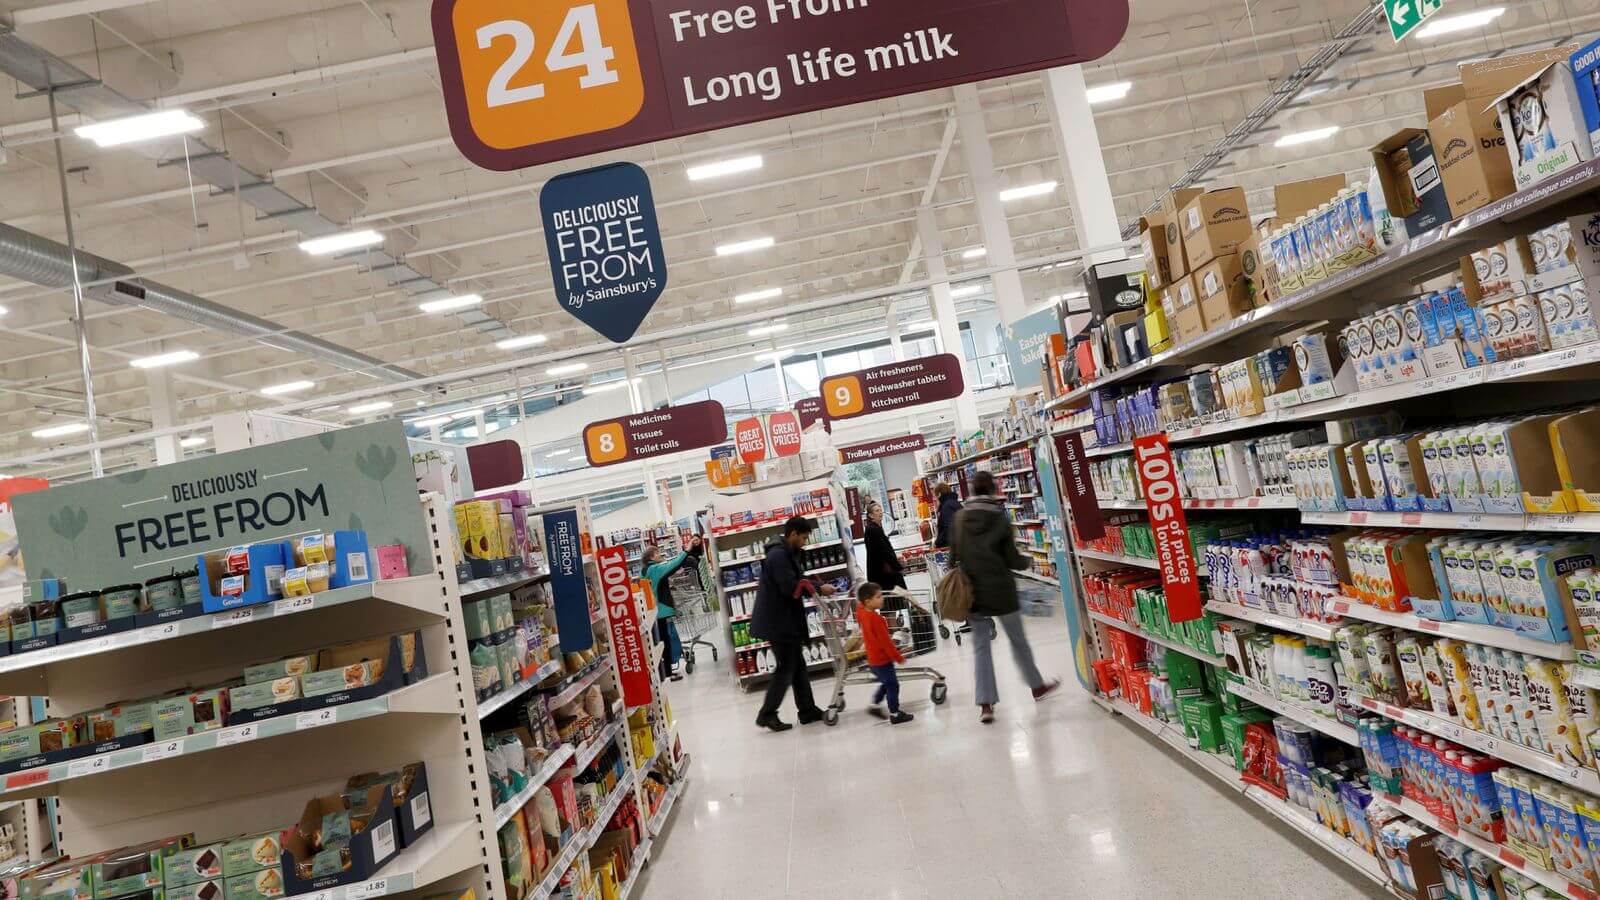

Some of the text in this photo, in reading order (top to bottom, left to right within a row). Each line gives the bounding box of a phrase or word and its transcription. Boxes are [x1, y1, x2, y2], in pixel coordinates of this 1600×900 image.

[669, 5, 756, 42] Free
[475, 3, 619, 108] 24
[1574, 50, 1595, 72] GOOD
[682, 27, 958, 106] Long life milk
[1537, 152, 1568, 174] Original
[1489, 203, 1506, 218] shelf
[1513, 197, 1523, 207] for
[1524, 182, 1560, 203] colleague
[1560, 176, 1574, 187] use
[553, 195, 639, 230] DELICIOUSLY
[557, 216, 648, 262] FREE
[562, 247, 653, 290] FROM
[568, 277, 657, 308] by Sainsbury's
[1018, 331, 1047, 350] Easter
[866, 363, 924, 381] Air fresheners
[1400, 364, 1415, 377] Light
[868, 373, 946, 395] Dishwasher tablets
[835, 386, 850, 407] 9
[871, 392, 920, 409] Kitchen roll
[629, 412, 673, 428] Medicines
[773, 421, 796, 434] GREAT
[599, 433, 615, 453] 8
[632, 429, 663, 441] Tissues
[739, 428, 760, 442] GREAT
[773, 433, 800, 447] PRICES
[634, 440, 680, 456] Toilet rolls
[740, 439, 764, 454] PRICES
[846, 439, 921, 460] Trolley self checkout
[1065, 439, 1086, 497] Long life milk
[172, 469, 258, 503] DELICIOUSLY
[1138, 441, 1175, 520] 100s
[115, 483, 331, 558] FREE FROM
[557, 521, 573, 576] FREE FROM
[1156, 524, 1179, 584] lowered
[1169, 520, 1190, 584] of prices
[1558, 558, 1593, 572] alpro
[600, 551, 629, 620] 100s
[293, 597, 312, 607] £2.25
[614, 623, 633, 673] lowered
[624, 618, 642, 673] of prices
[320, 711, 330, 720] £2
[241, 728, 251, 736] £2
[167, 743, 177, 751] £2
[93, 759, 103, 767] £2
[1570, 769, 1579, 779] £2
[366, 881, 385, 892] £1.85
